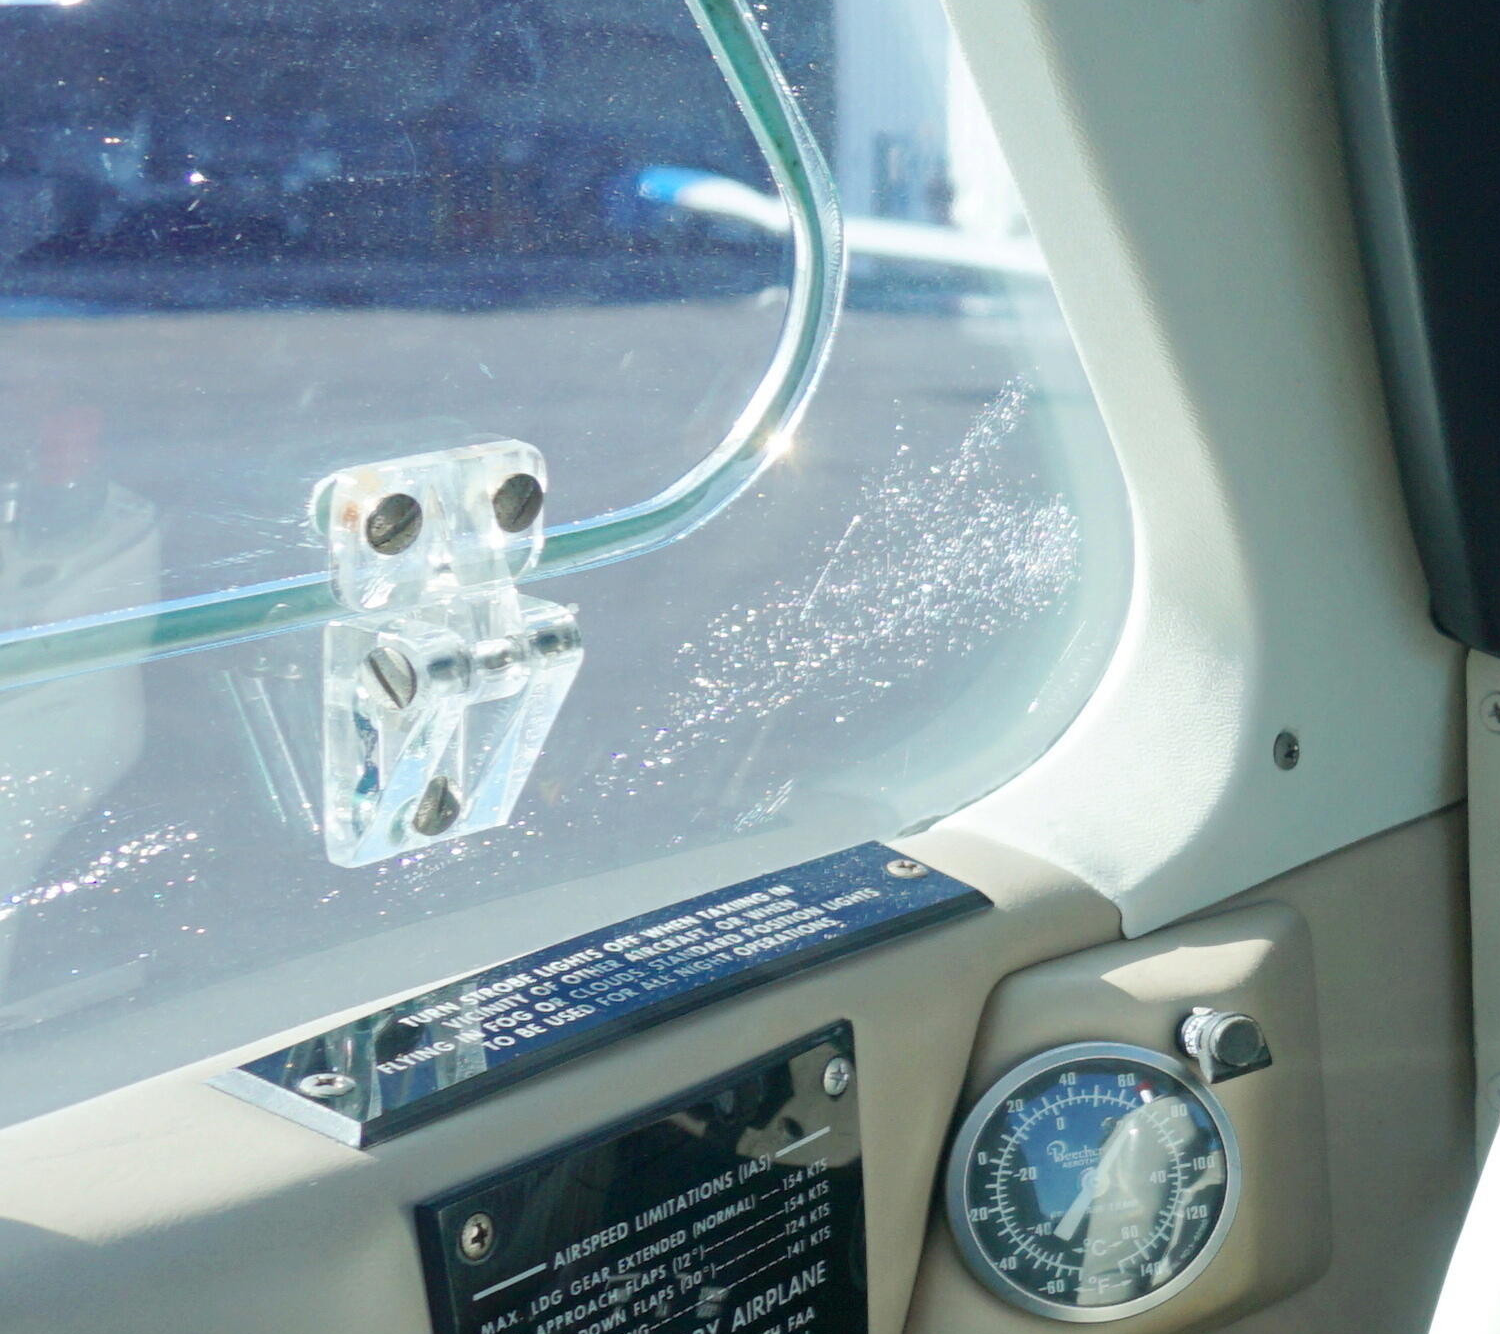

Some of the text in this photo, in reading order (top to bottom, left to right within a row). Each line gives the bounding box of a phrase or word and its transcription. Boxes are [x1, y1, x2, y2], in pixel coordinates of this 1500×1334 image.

[398, 1002, 460, 1028] TURN
[461, 976, 534, 1005] STROBE
[535, 949, 603, 976] LIGHTS
[603, 935, 641, 953] OFF
[643, 915, 701, 939] WHEN
[768, 885, 795, 897] IN
[442, 993, 530, 1030] VICINITY
[530, 982, 558, 996] OF
[561, 959, 625, 985] OTHER
[715, 917, 747, 931] OR
[742, 899, 800, 921] WHEN
[553, 1221, 628, 1270] AIRSPEED
[634, 1171, 733, 1233] LIMITATIONS
[731, 1259, 827, 1333] AIRPLANE
